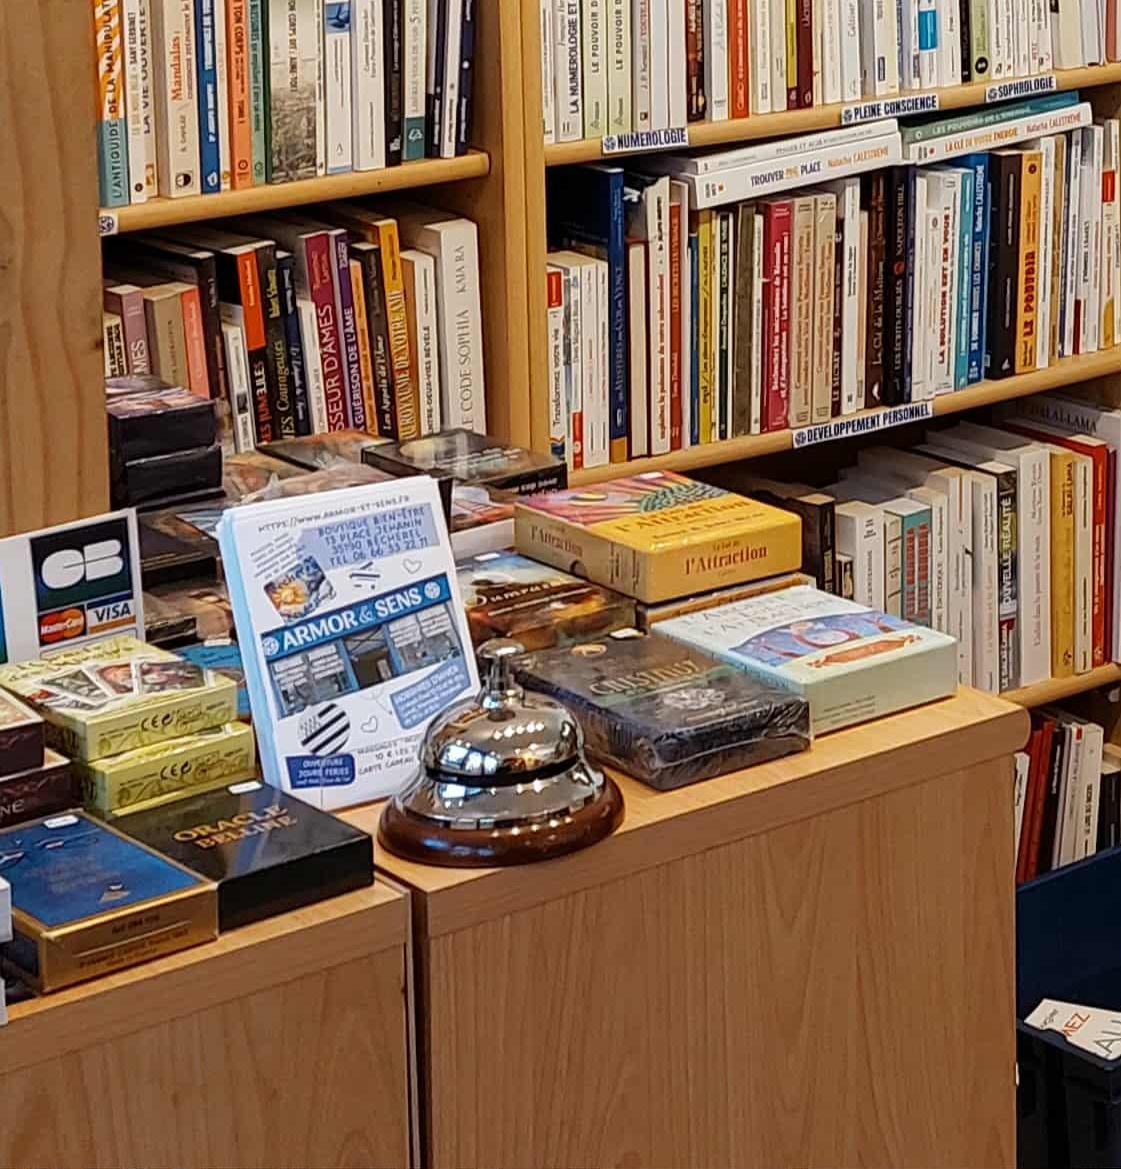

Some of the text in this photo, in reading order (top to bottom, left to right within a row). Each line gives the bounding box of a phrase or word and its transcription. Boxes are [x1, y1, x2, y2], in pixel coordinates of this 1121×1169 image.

[568, 2, 578, 15] ET
[590, 11, 599, 58] POUVOIR
[614, 9, 623, 55] POUVOIR
[170, 35, 183, 101] Mandalas
[568, 18, 578, 96] NUMEROLOGIE
[591, 61, 600, 73] LE
[615, 58, 623, 70] LE
[107, 78, 116, 93] LA
[997, 76, 1054, 98] SOPHROLOGIE
[107, 98, 117, 114] DE
[570, 99, 579, 114] LA
[854, 95, 937, 120] PLEINE CONSCIENCE
[617, 127, 686, 149] NUMEROLOGIE
[108, 121, 122, 199] L'ANTIGUIDE
[342, 307, 364, 424] GUÉRISON DE L'ÂME
[807, 403, 930, 443] DEVELOPPEMENT PERSONNEL
[684, 544, 769, 576] l'Attraction
[93, 602, 132, 622] VISA
[283, 588, 423, 651] ARMOR & SENS
[173, 805, 289, 844] ORACLE
